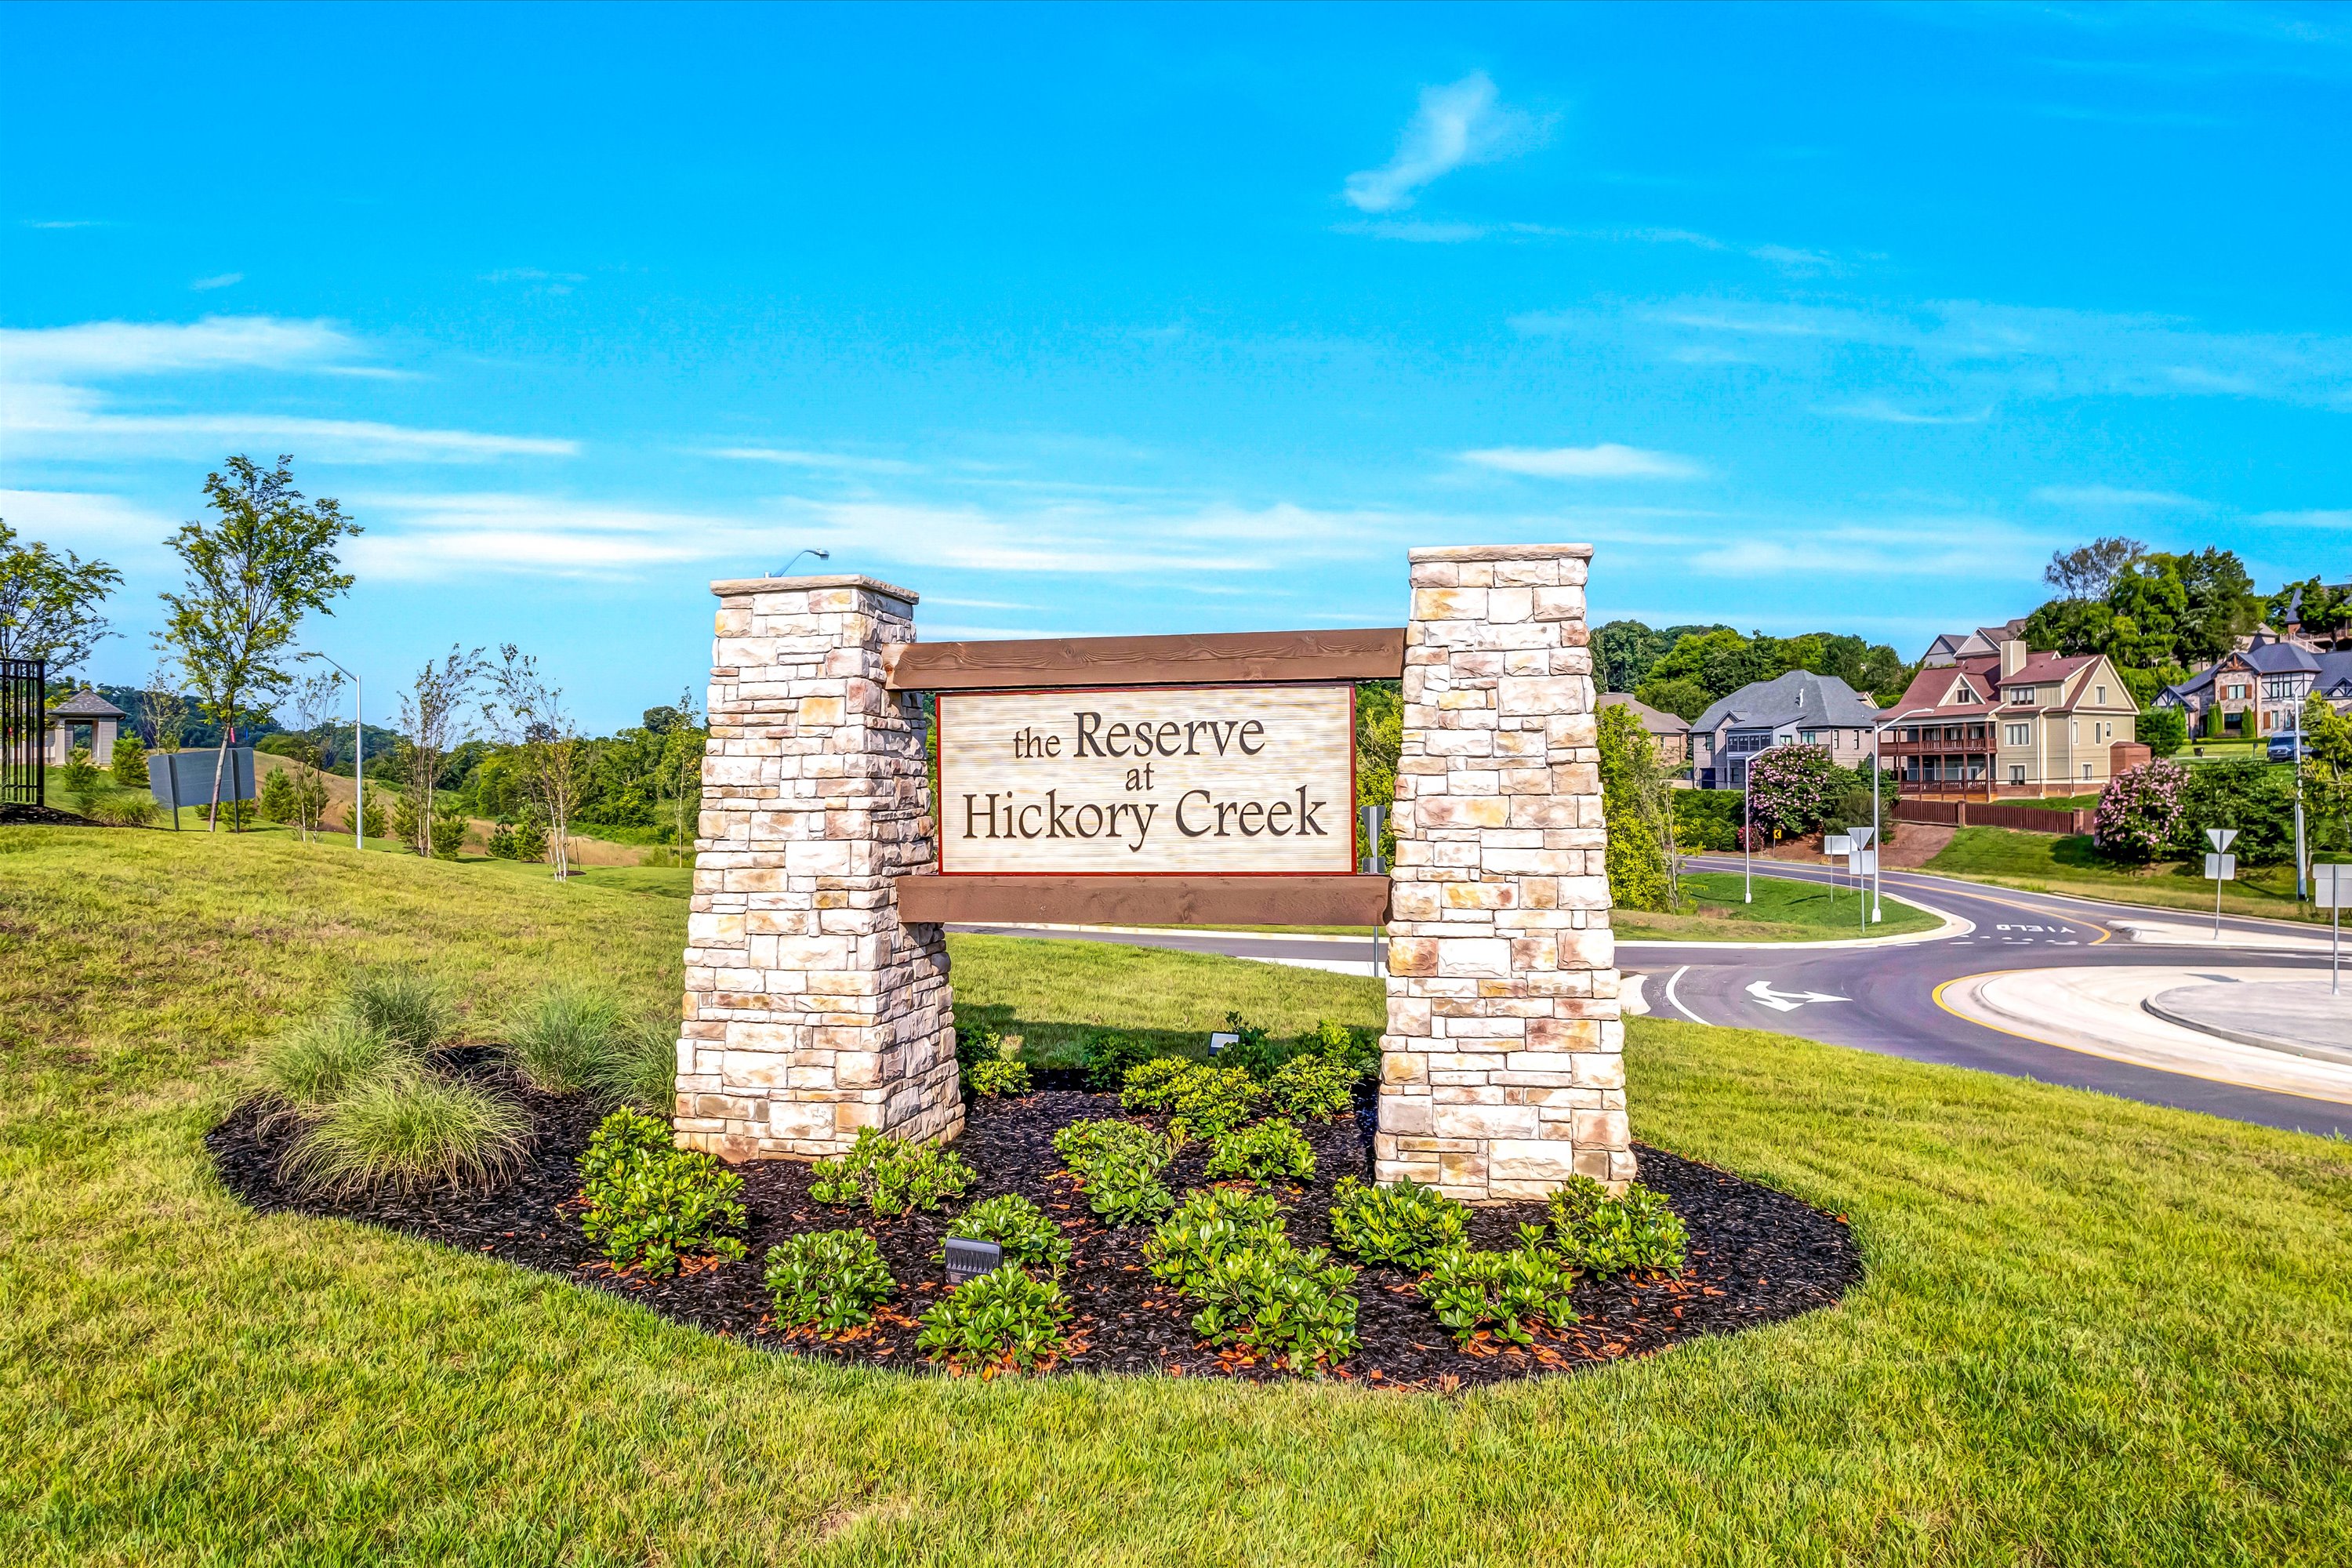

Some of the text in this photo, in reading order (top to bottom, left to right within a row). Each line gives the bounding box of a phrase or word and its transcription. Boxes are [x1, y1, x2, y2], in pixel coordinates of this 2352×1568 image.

[1012, 711, 1266, 759] the Reserve
[1125, 761, 1155, 791] at
[962, 784, 1328, 853] Hickory Creek
[1996, 924, 2076, 934] YIELD
